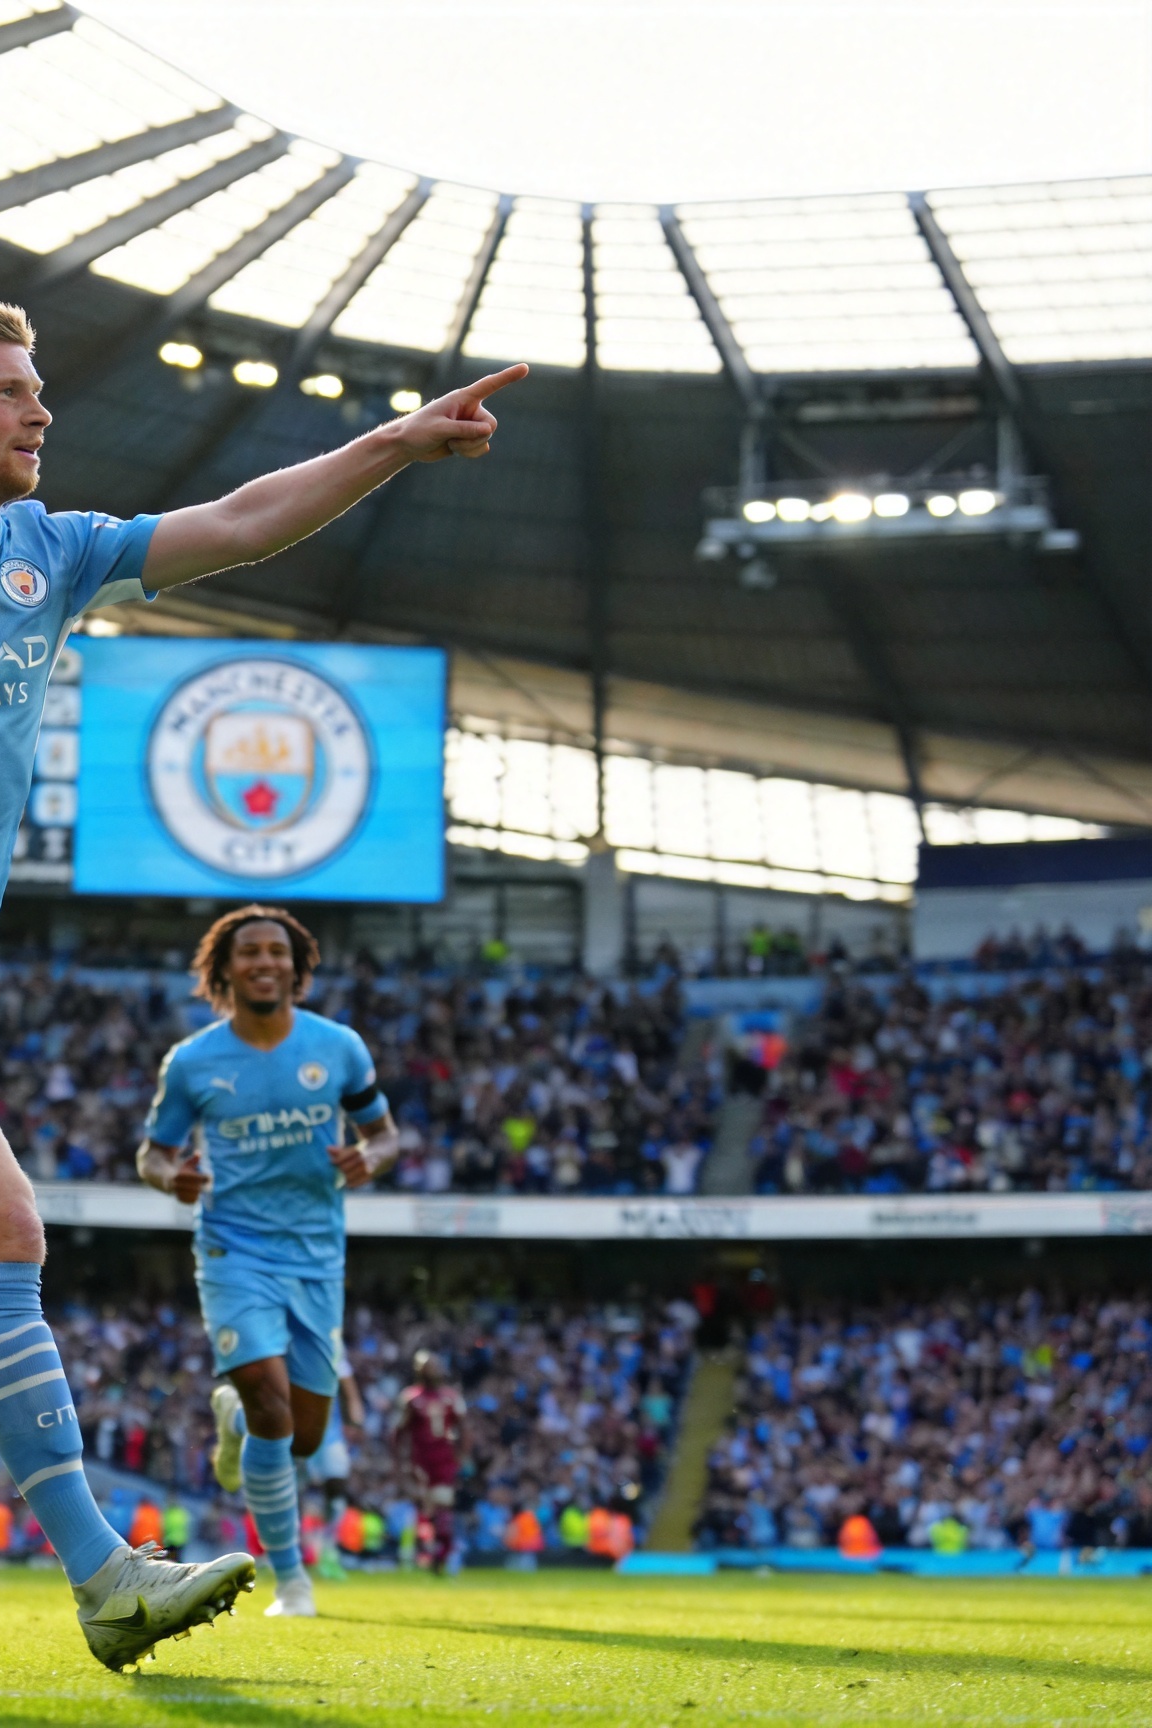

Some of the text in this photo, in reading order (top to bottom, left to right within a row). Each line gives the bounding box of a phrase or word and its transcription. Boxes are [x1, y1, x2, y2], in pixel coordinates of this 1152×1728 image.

[223, 835, 299, 867] CITY
[217, 1103, 333, 1140] ETIHAD
[36, 1403, 78, 1429] CIT
